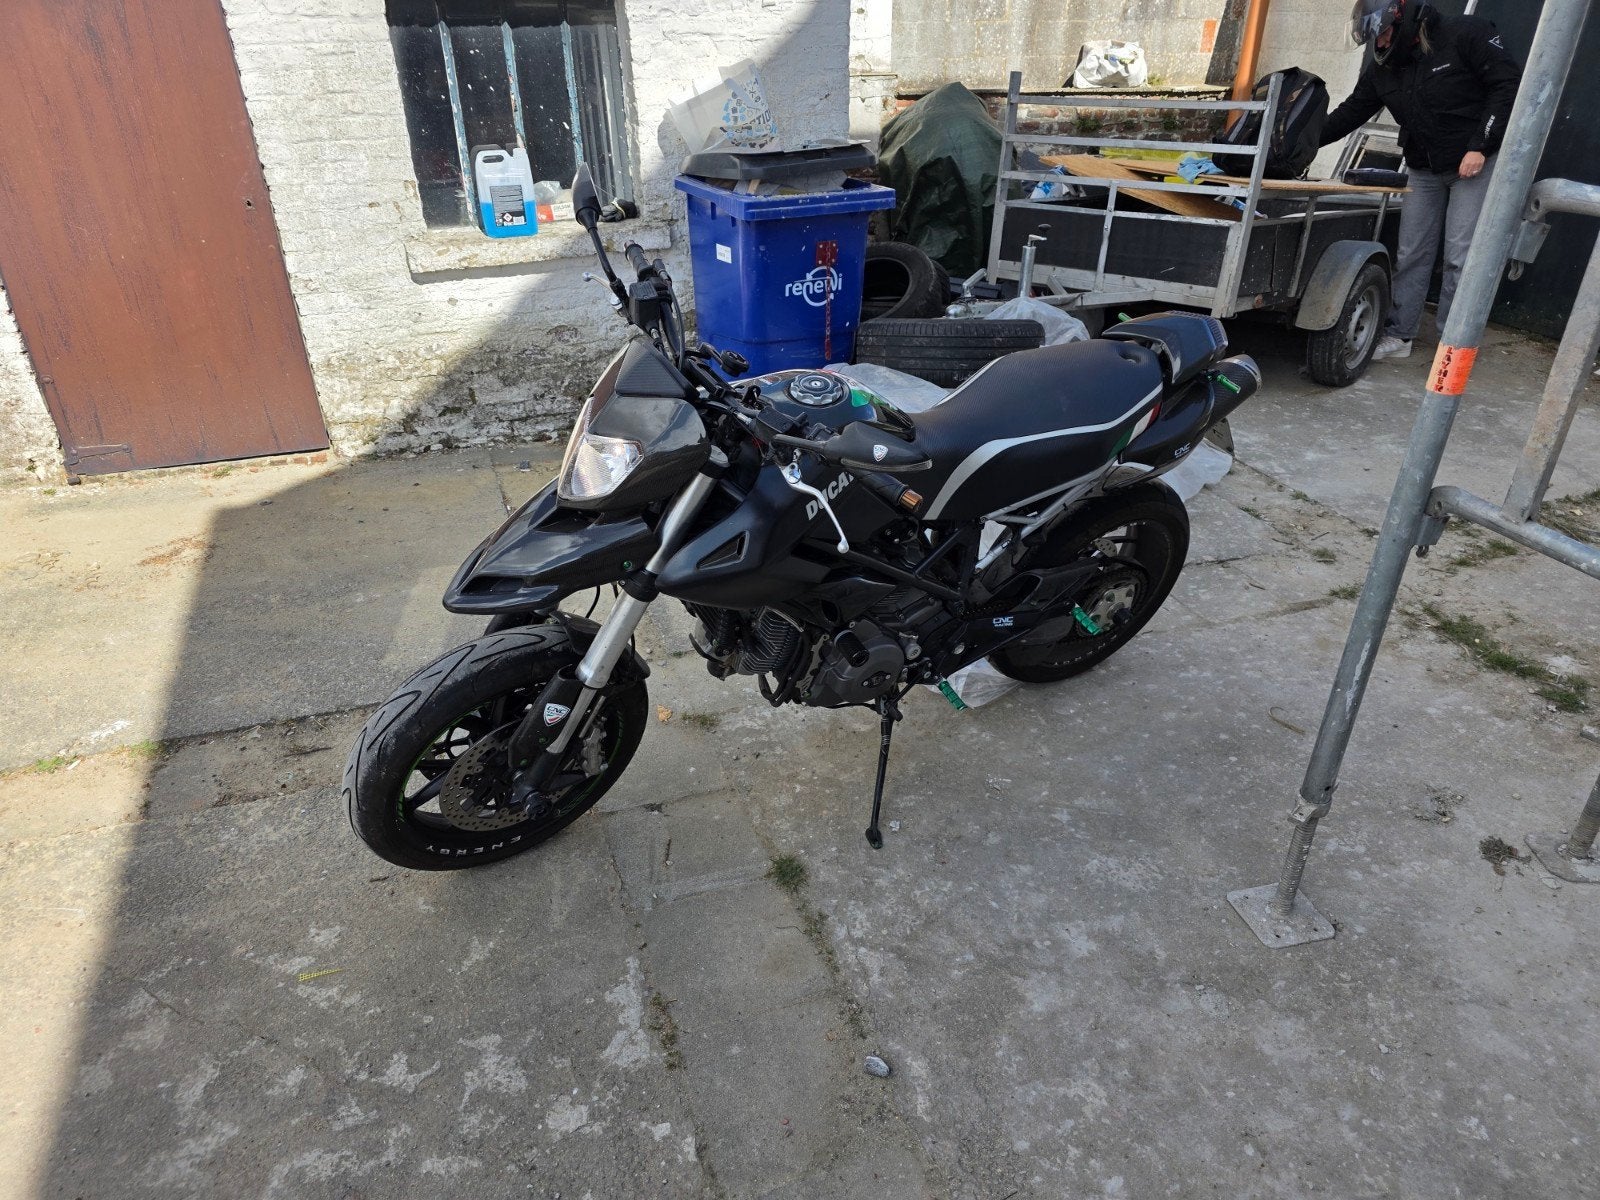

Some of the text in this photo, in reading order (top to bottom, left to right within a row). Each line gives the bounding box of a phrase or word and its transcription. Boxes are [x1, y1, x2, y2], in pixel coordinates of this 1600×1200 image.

[805, 471, 854, 521] DUCA
[993, 616, 1014, 624] CNC
[425, 834, 522, 857] ENERGY
